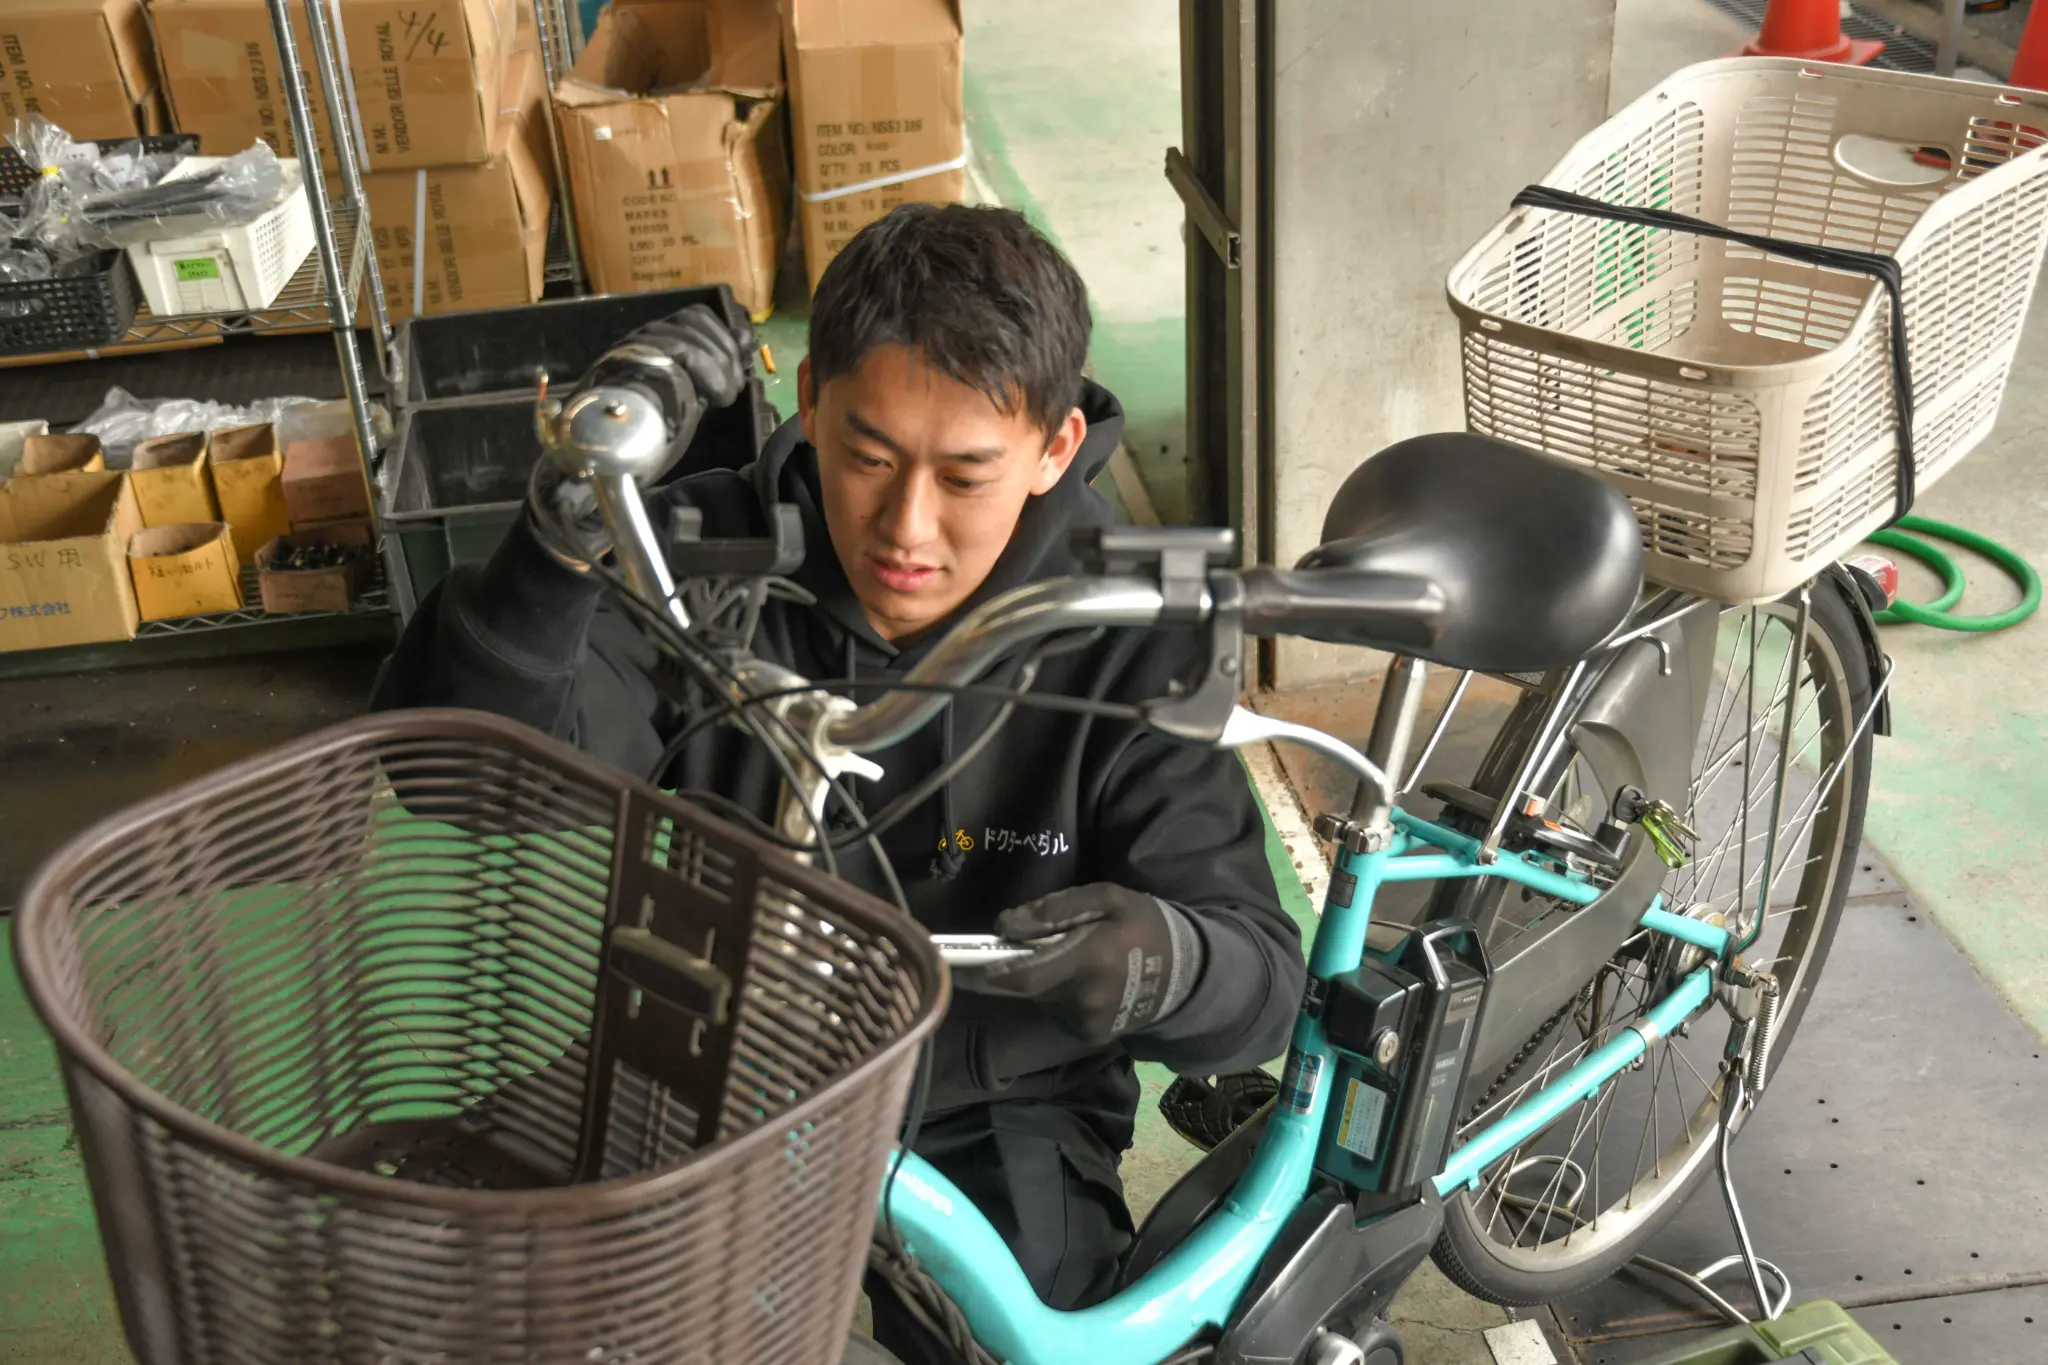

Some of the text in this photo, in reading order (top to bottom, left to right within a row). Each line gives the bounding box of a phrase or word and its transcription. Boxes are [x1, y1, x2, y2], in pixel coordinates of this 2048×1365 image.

[1, 33, 26, 66] ITEM
[375, 20, 396, 62] ROYAL
[398, 9, 451, 62] 4/4
[383, 65, 402, 101] SELLE
[816, 123, 843, 138] ITEM
[983, 826, 1069, 856] ドクターペダル
